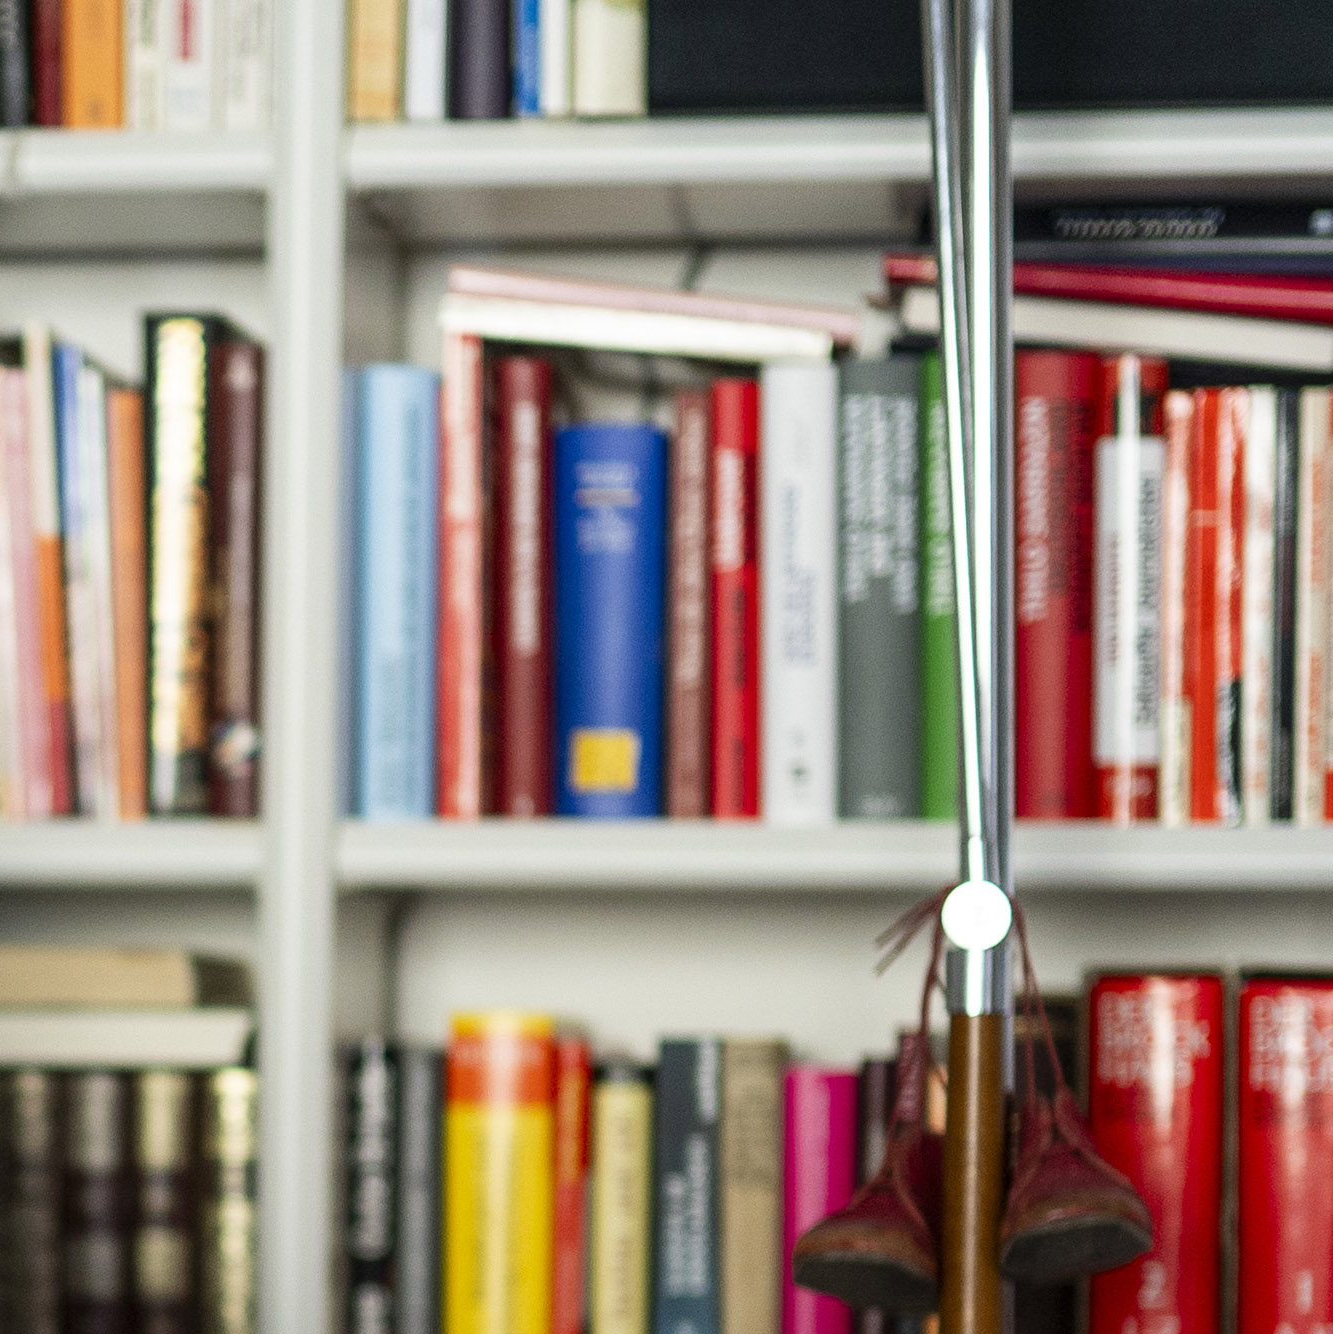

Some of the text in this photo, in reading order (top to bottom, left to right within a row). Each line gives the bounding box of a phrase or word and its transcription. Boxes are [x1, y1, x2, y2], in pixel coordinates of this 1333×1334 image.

[1021, 397, 1050, 623] THILO SARRAZIN
[1138, 1259, 1169, 1310] 2
[1295, 1268, 1314, 1315] 1
